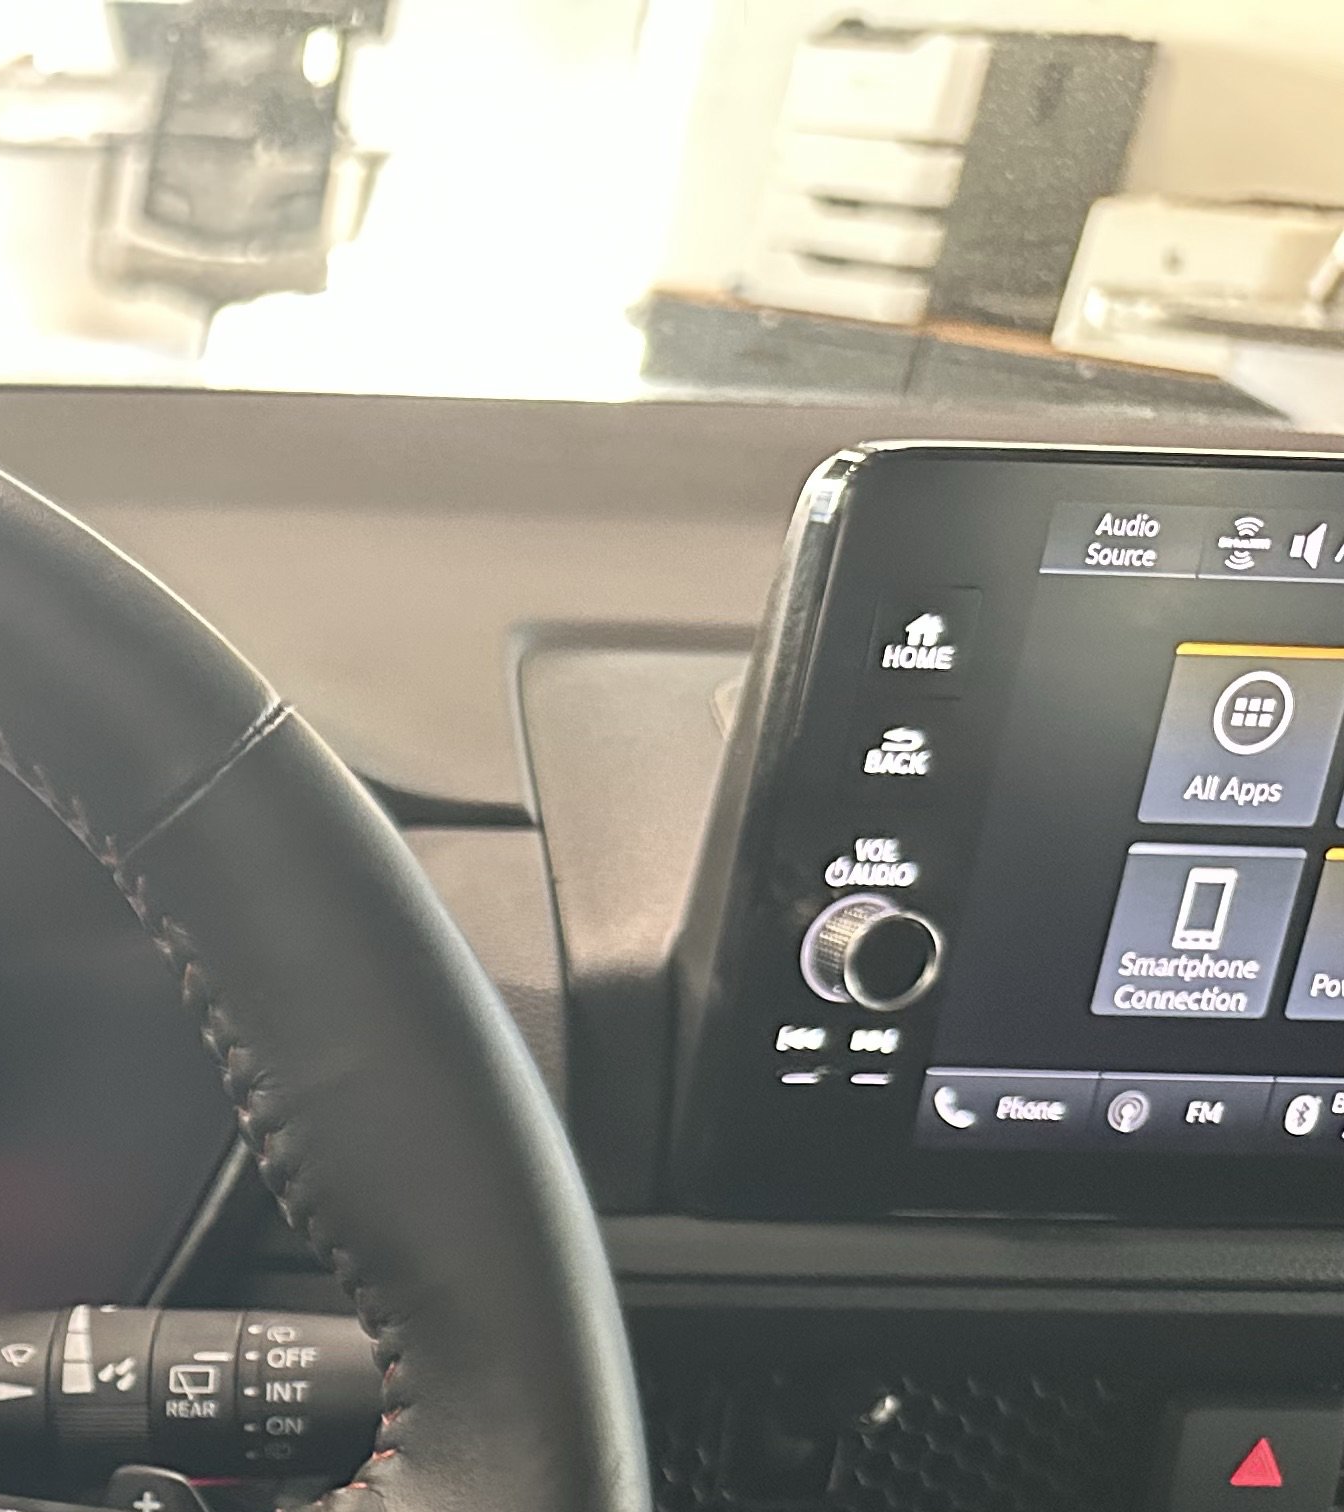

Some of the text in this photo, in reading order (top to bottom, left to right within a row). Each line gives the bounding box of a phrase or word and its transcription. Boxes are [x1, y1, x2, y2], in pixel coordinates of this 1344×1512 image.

[1095, 512, 1160, 537] Audio
[1085, 541, 1157, 567] Source
[882, 644, 955, 669] HOME
[864, 748, 930, 774] BACK
[1183, 775, 1282, 806] All Apps
[855, 838, 900, 862] VOL
[848, 861, 918, 886] AUDIO
[1118, 951, 1260, 982] Smartphone
[1113, 984, 1248, 1012] Connection
[996, 1095, 1066, 1120] Phone
[1186, 1100, 1225, 1124] FM
[267, 1347, 317, 1368] OFF
[265, 1380, 309, 1402] INT
[165, 1399, 216, 1418] REAR
[265, 1415, 304, 1435] ON
